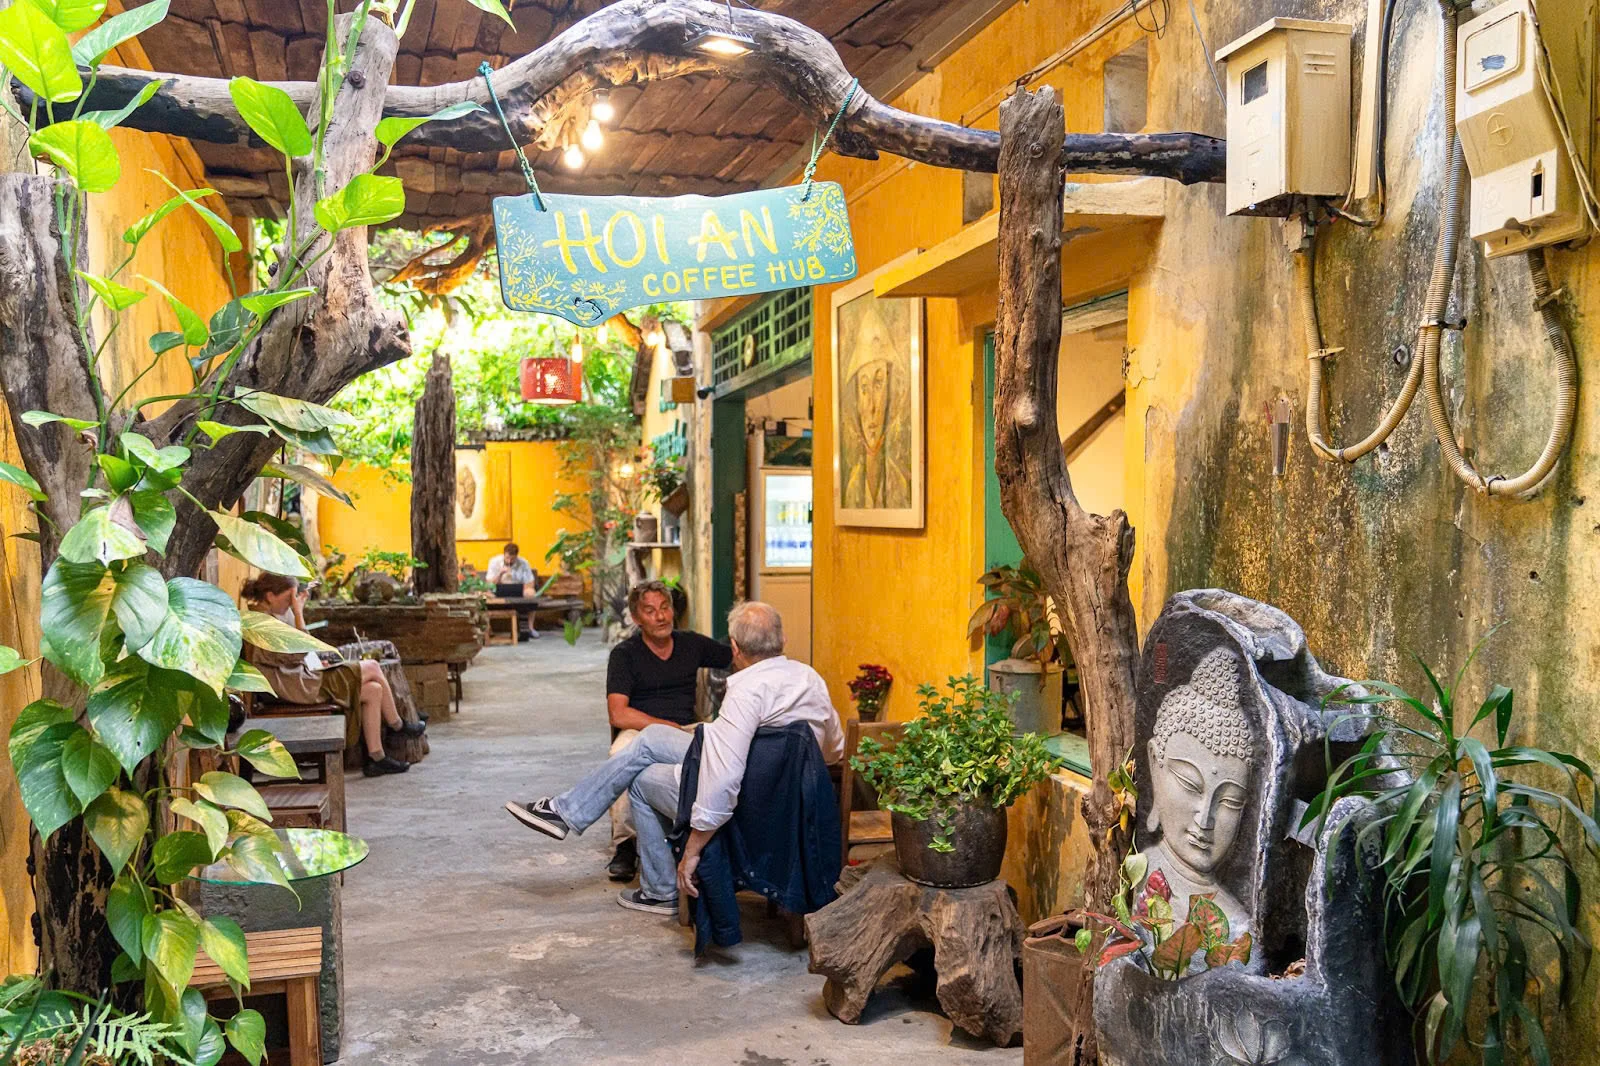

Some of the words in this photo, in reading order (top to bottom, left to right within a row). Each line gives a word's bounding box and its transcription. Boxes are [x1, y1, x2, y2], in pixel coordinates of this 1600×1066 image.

[542, 208, 671, 274] HOI
[688, 206, 779, 263] AN
[642, 263, 757, 297] COFFEE
[766, 256, 826, 284] HUB
